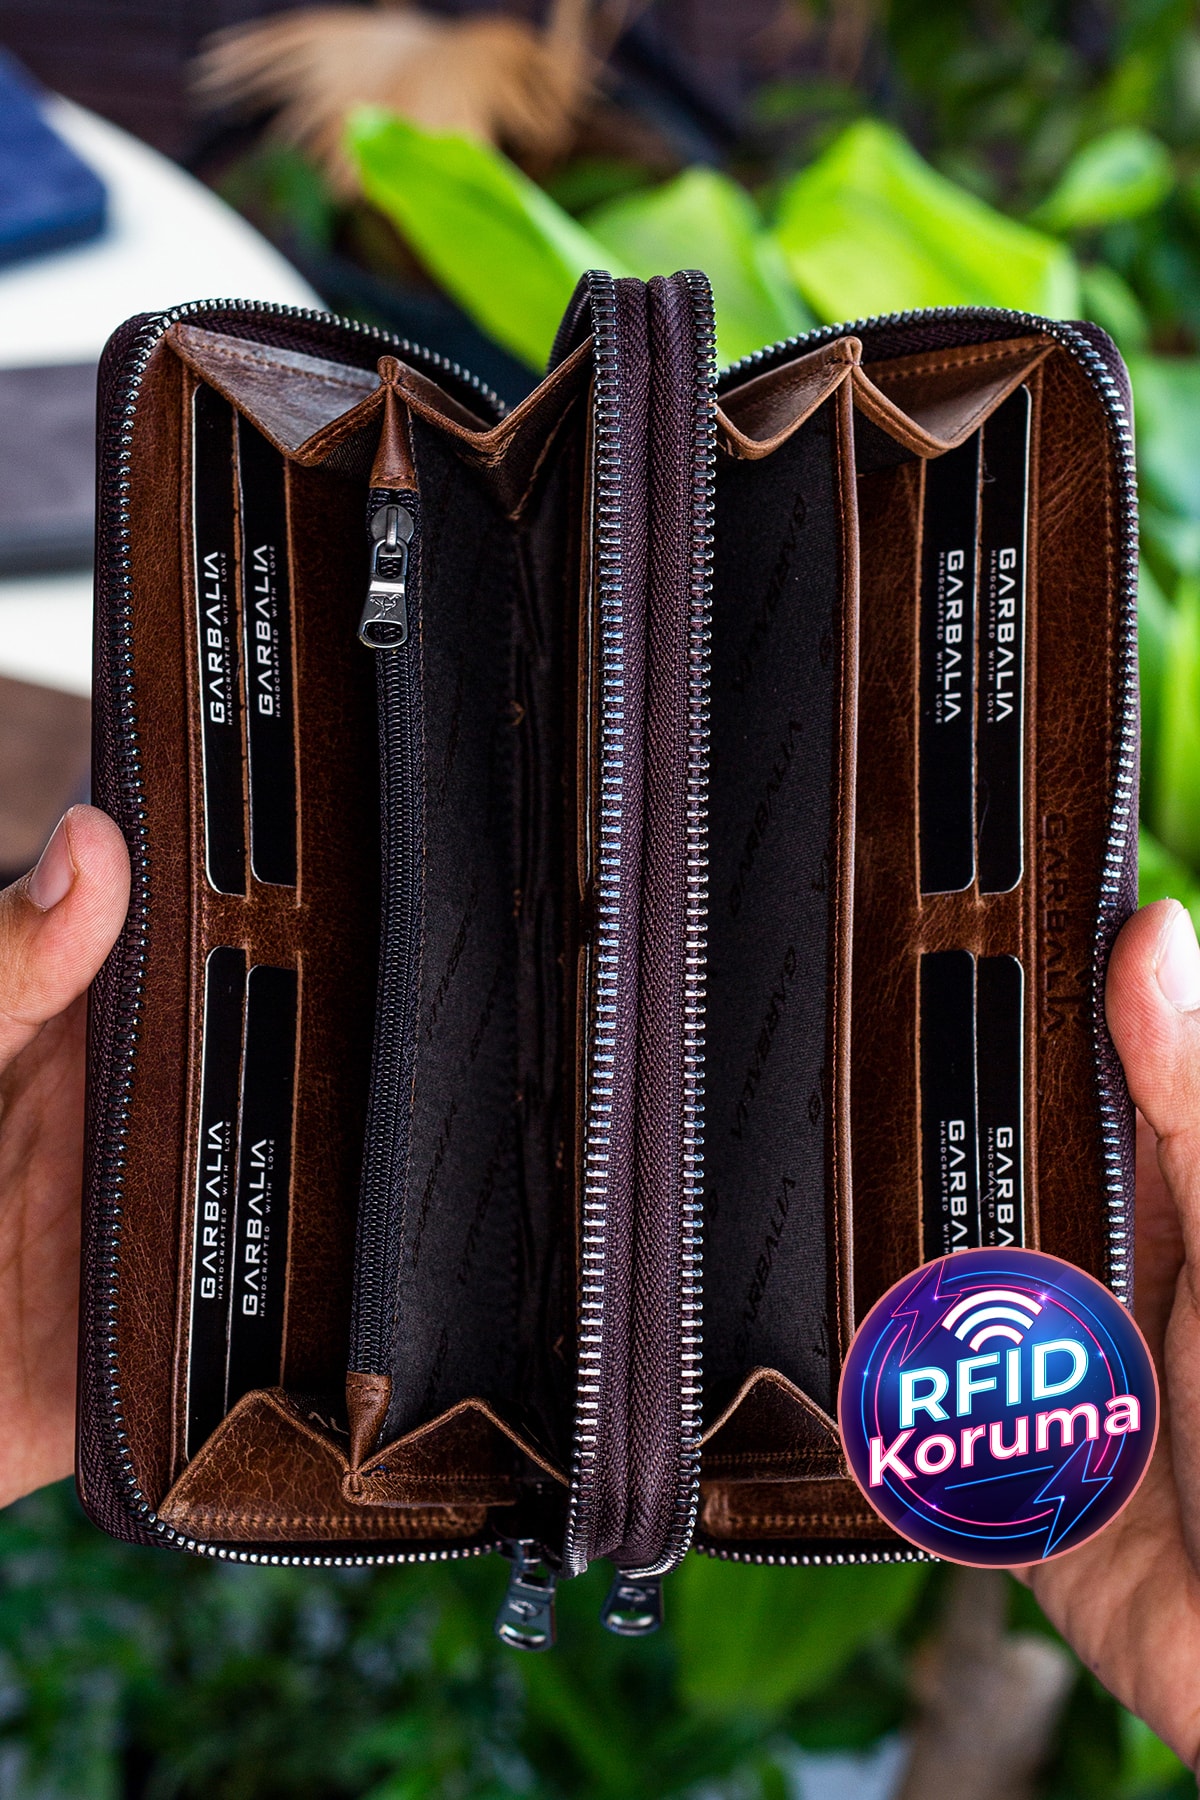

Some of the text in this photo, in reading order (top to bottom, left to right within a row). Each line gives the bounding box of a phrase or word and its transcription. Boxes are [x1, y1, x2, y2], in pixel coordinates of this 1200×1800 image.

[203, 552, 225, 723] GARBALIA
[253, 545, 274, 715] GARBALIA
[937, 552, 945, 640] HANDCRAFTED
[944, 550, 964, 722] GARBALIA
[988, 550, 997, 639] HANDCRAFTED
[996, 548, 1016, 722] GARBALIA
[223, 636, 233, 726] HANDCRAFTED
[272, 629, 281, 717] HANDCRAFTED
[1043, 814, 1068, 1033] GARBALIA
[200, 1121, 223, 1298] GARBALIA
[242, 1139, 267, 1315] GARBALIA
[260, 1225, 270, 1316] HANDCRAFTED
[267, 1139, 275, 1170] LOVE
[940, 1121, 948, 1211] HANDCRAFTED
[949, 1120, 968, 1253] GARBAL
[997, 1127, 1014, 1247] GARBA
[218, 1208, 227, 1299] HANDCRAFTED
